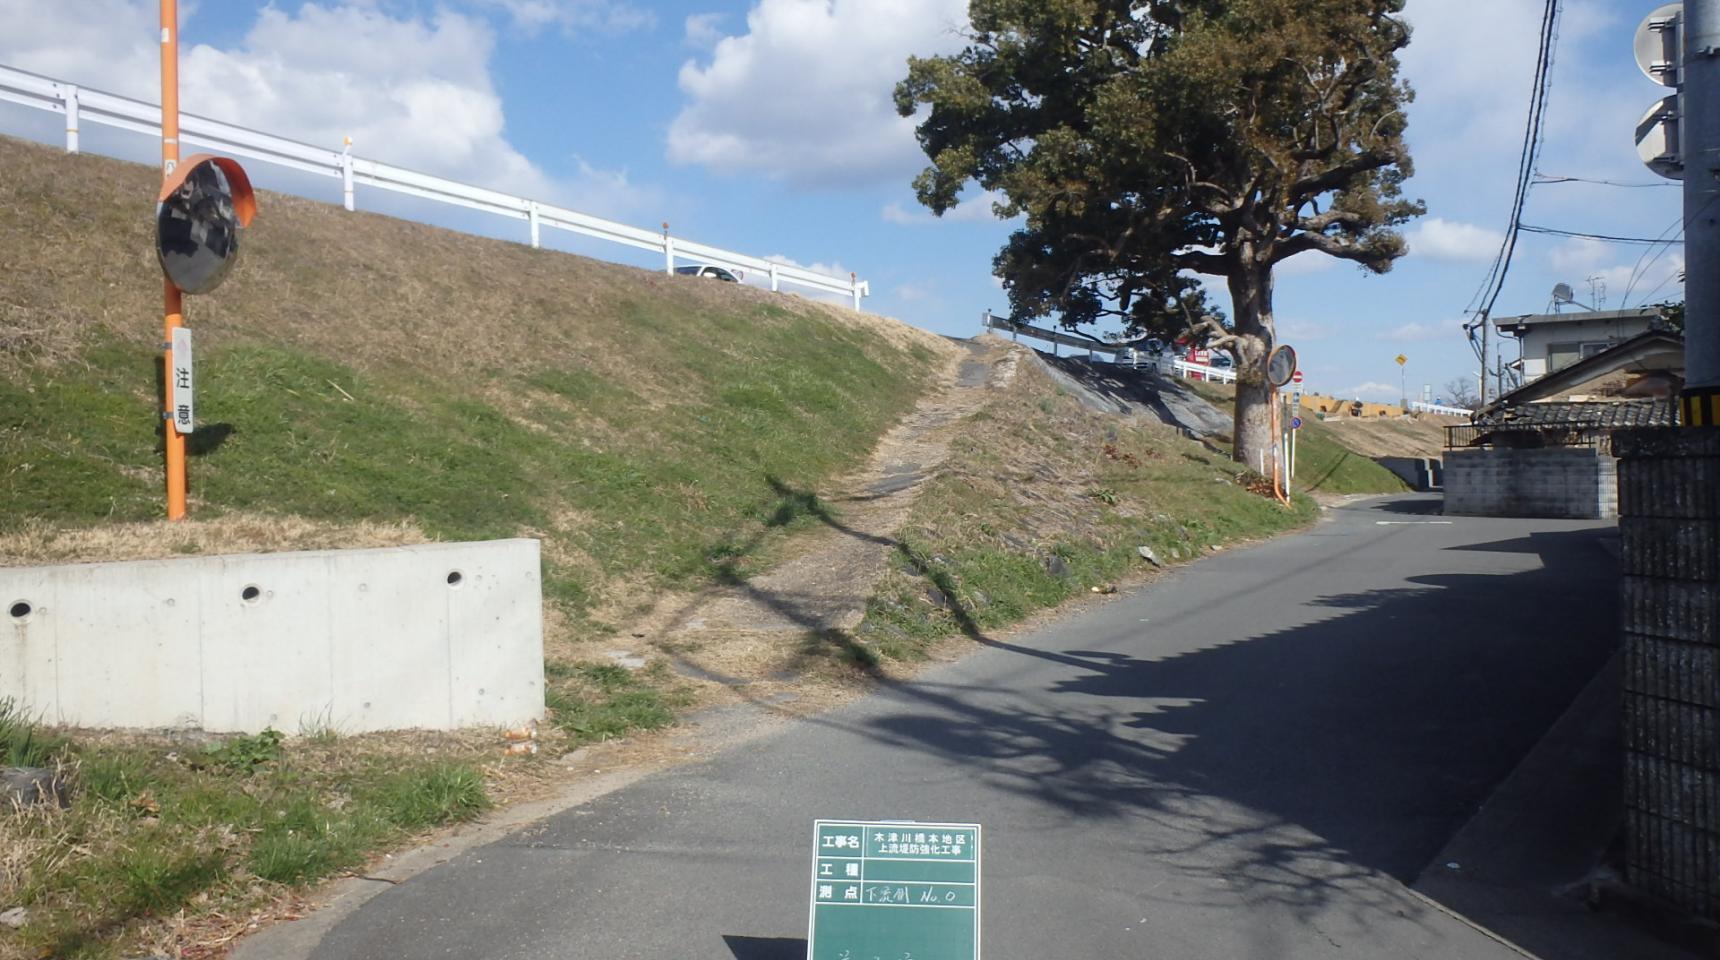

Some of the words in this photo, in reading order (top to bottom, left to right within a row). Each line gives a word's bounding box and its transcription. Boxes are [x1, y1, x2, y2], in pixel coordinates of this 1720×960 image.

[821, 835, 860, 849] 工事名
[873, 832, 966, 845] 木津川橋本地区
[878, 843, 962, 855] 上流堤防強化工事
